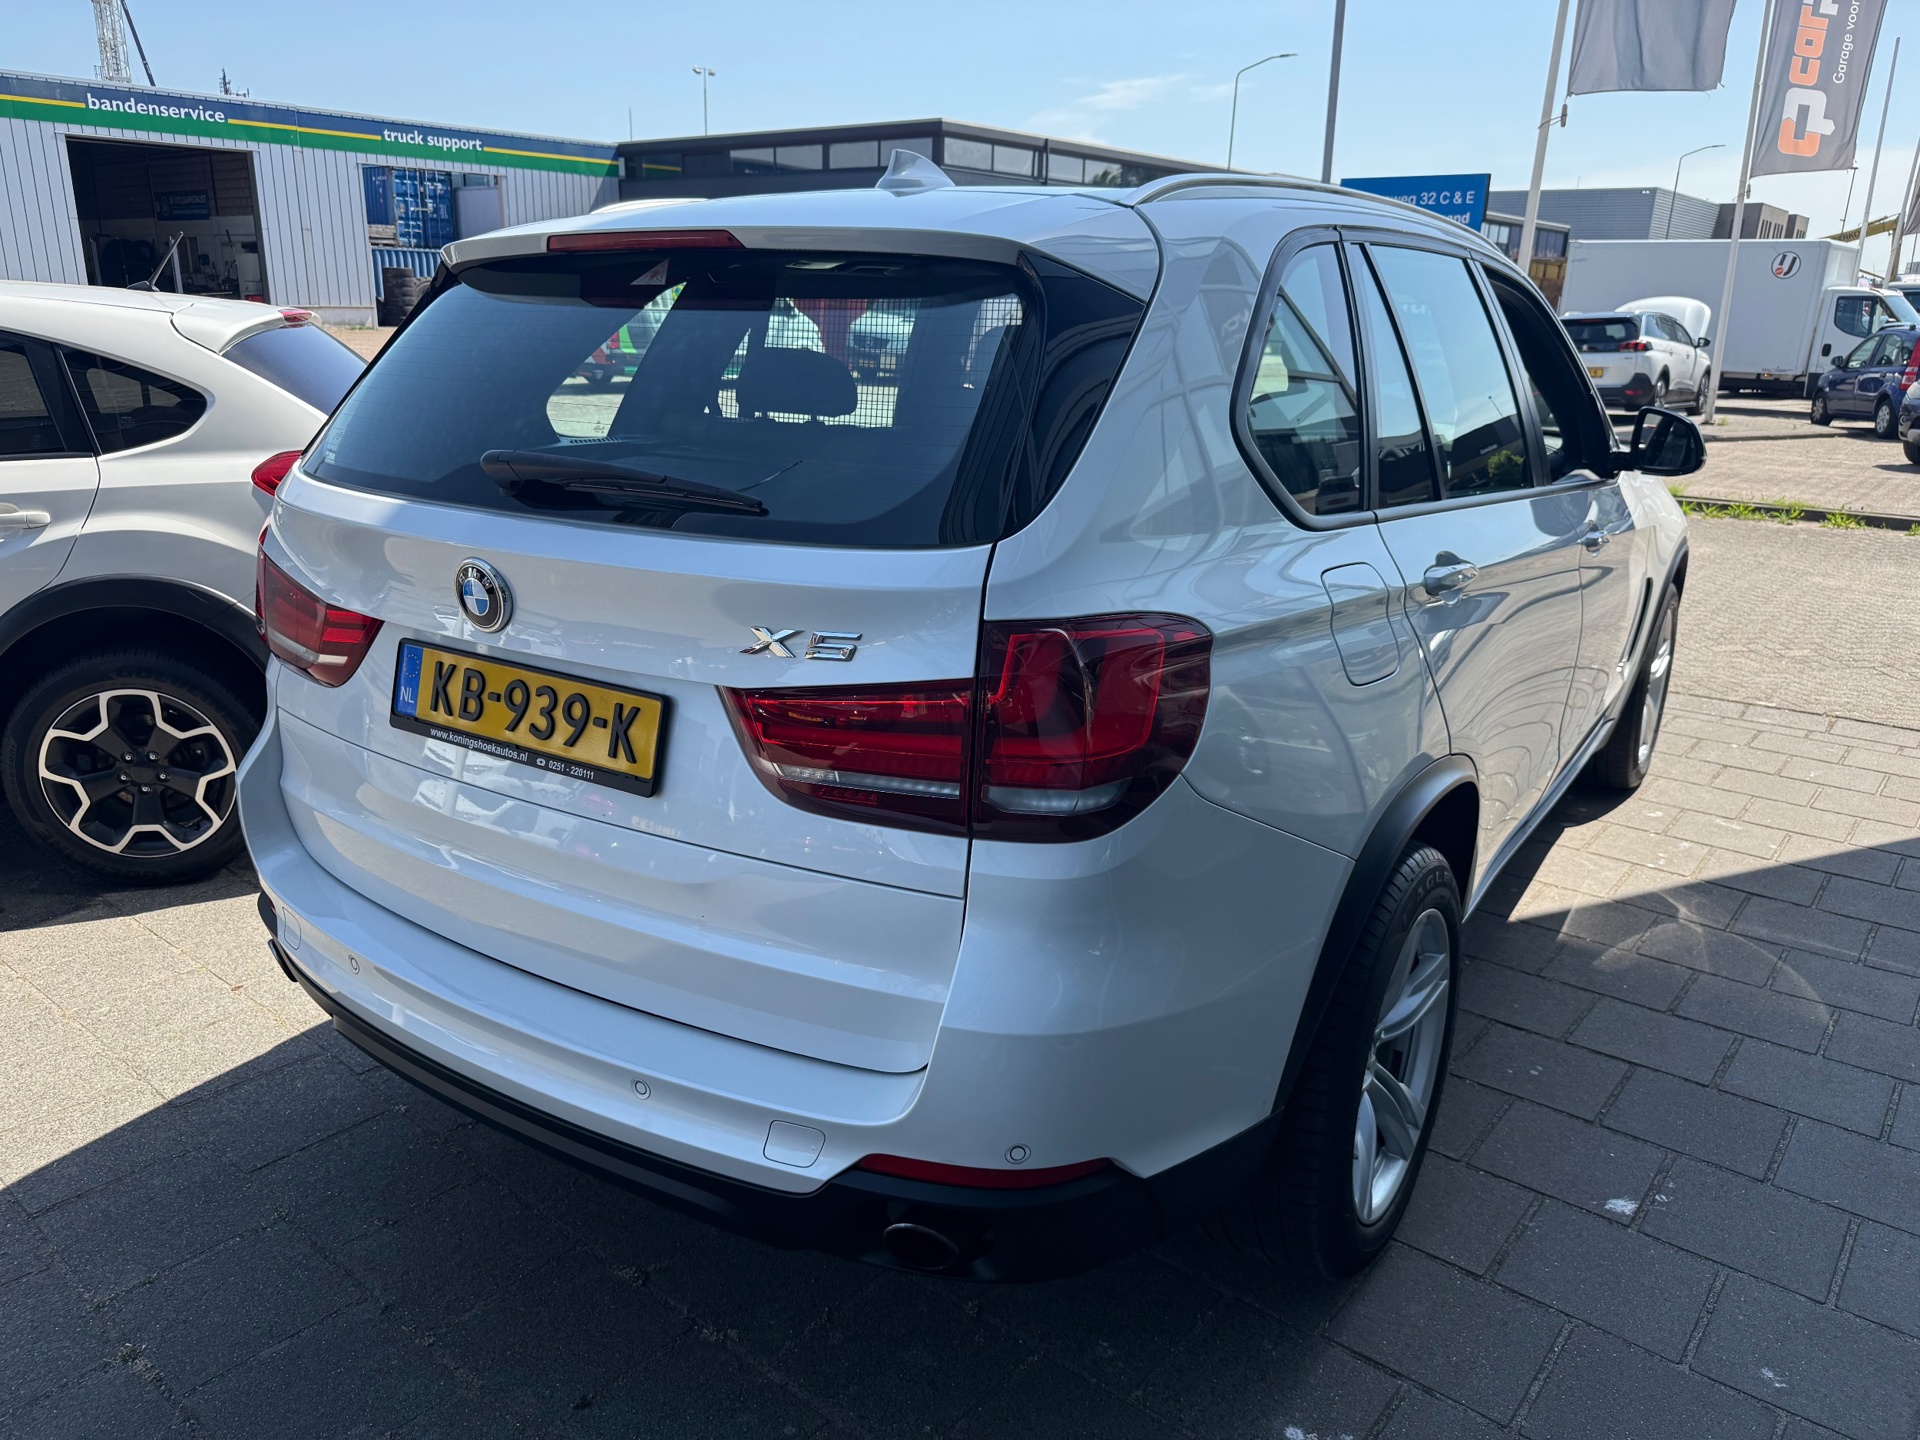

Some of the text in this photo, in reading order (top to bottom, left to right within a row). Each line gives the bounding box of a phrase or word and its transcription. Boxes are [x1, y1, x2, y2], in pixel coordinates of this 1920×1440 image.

[1832, 0, 1860, 84] Garage voor
[86, 92, 226, 123] bandenservice
[383, 128, 483, 153] truck support
[1419, 191, 1437, 205] 32
[1439, 191, 1451, 205] C
[1452, 191, 1463, 204] &
[1465, 191, 1475, 204] E
[458, 566, 493, 590] BMW
[739, 625, 863, 662] X5
[400, 685, 415, 704] NL
[429, 660, 641, 764] KB-939-K
[429, 727, 529, 763] www.koningshoekautos.nl
[548, 760, 565, 773] 0251
[570, 766, 595, 780] 220111
